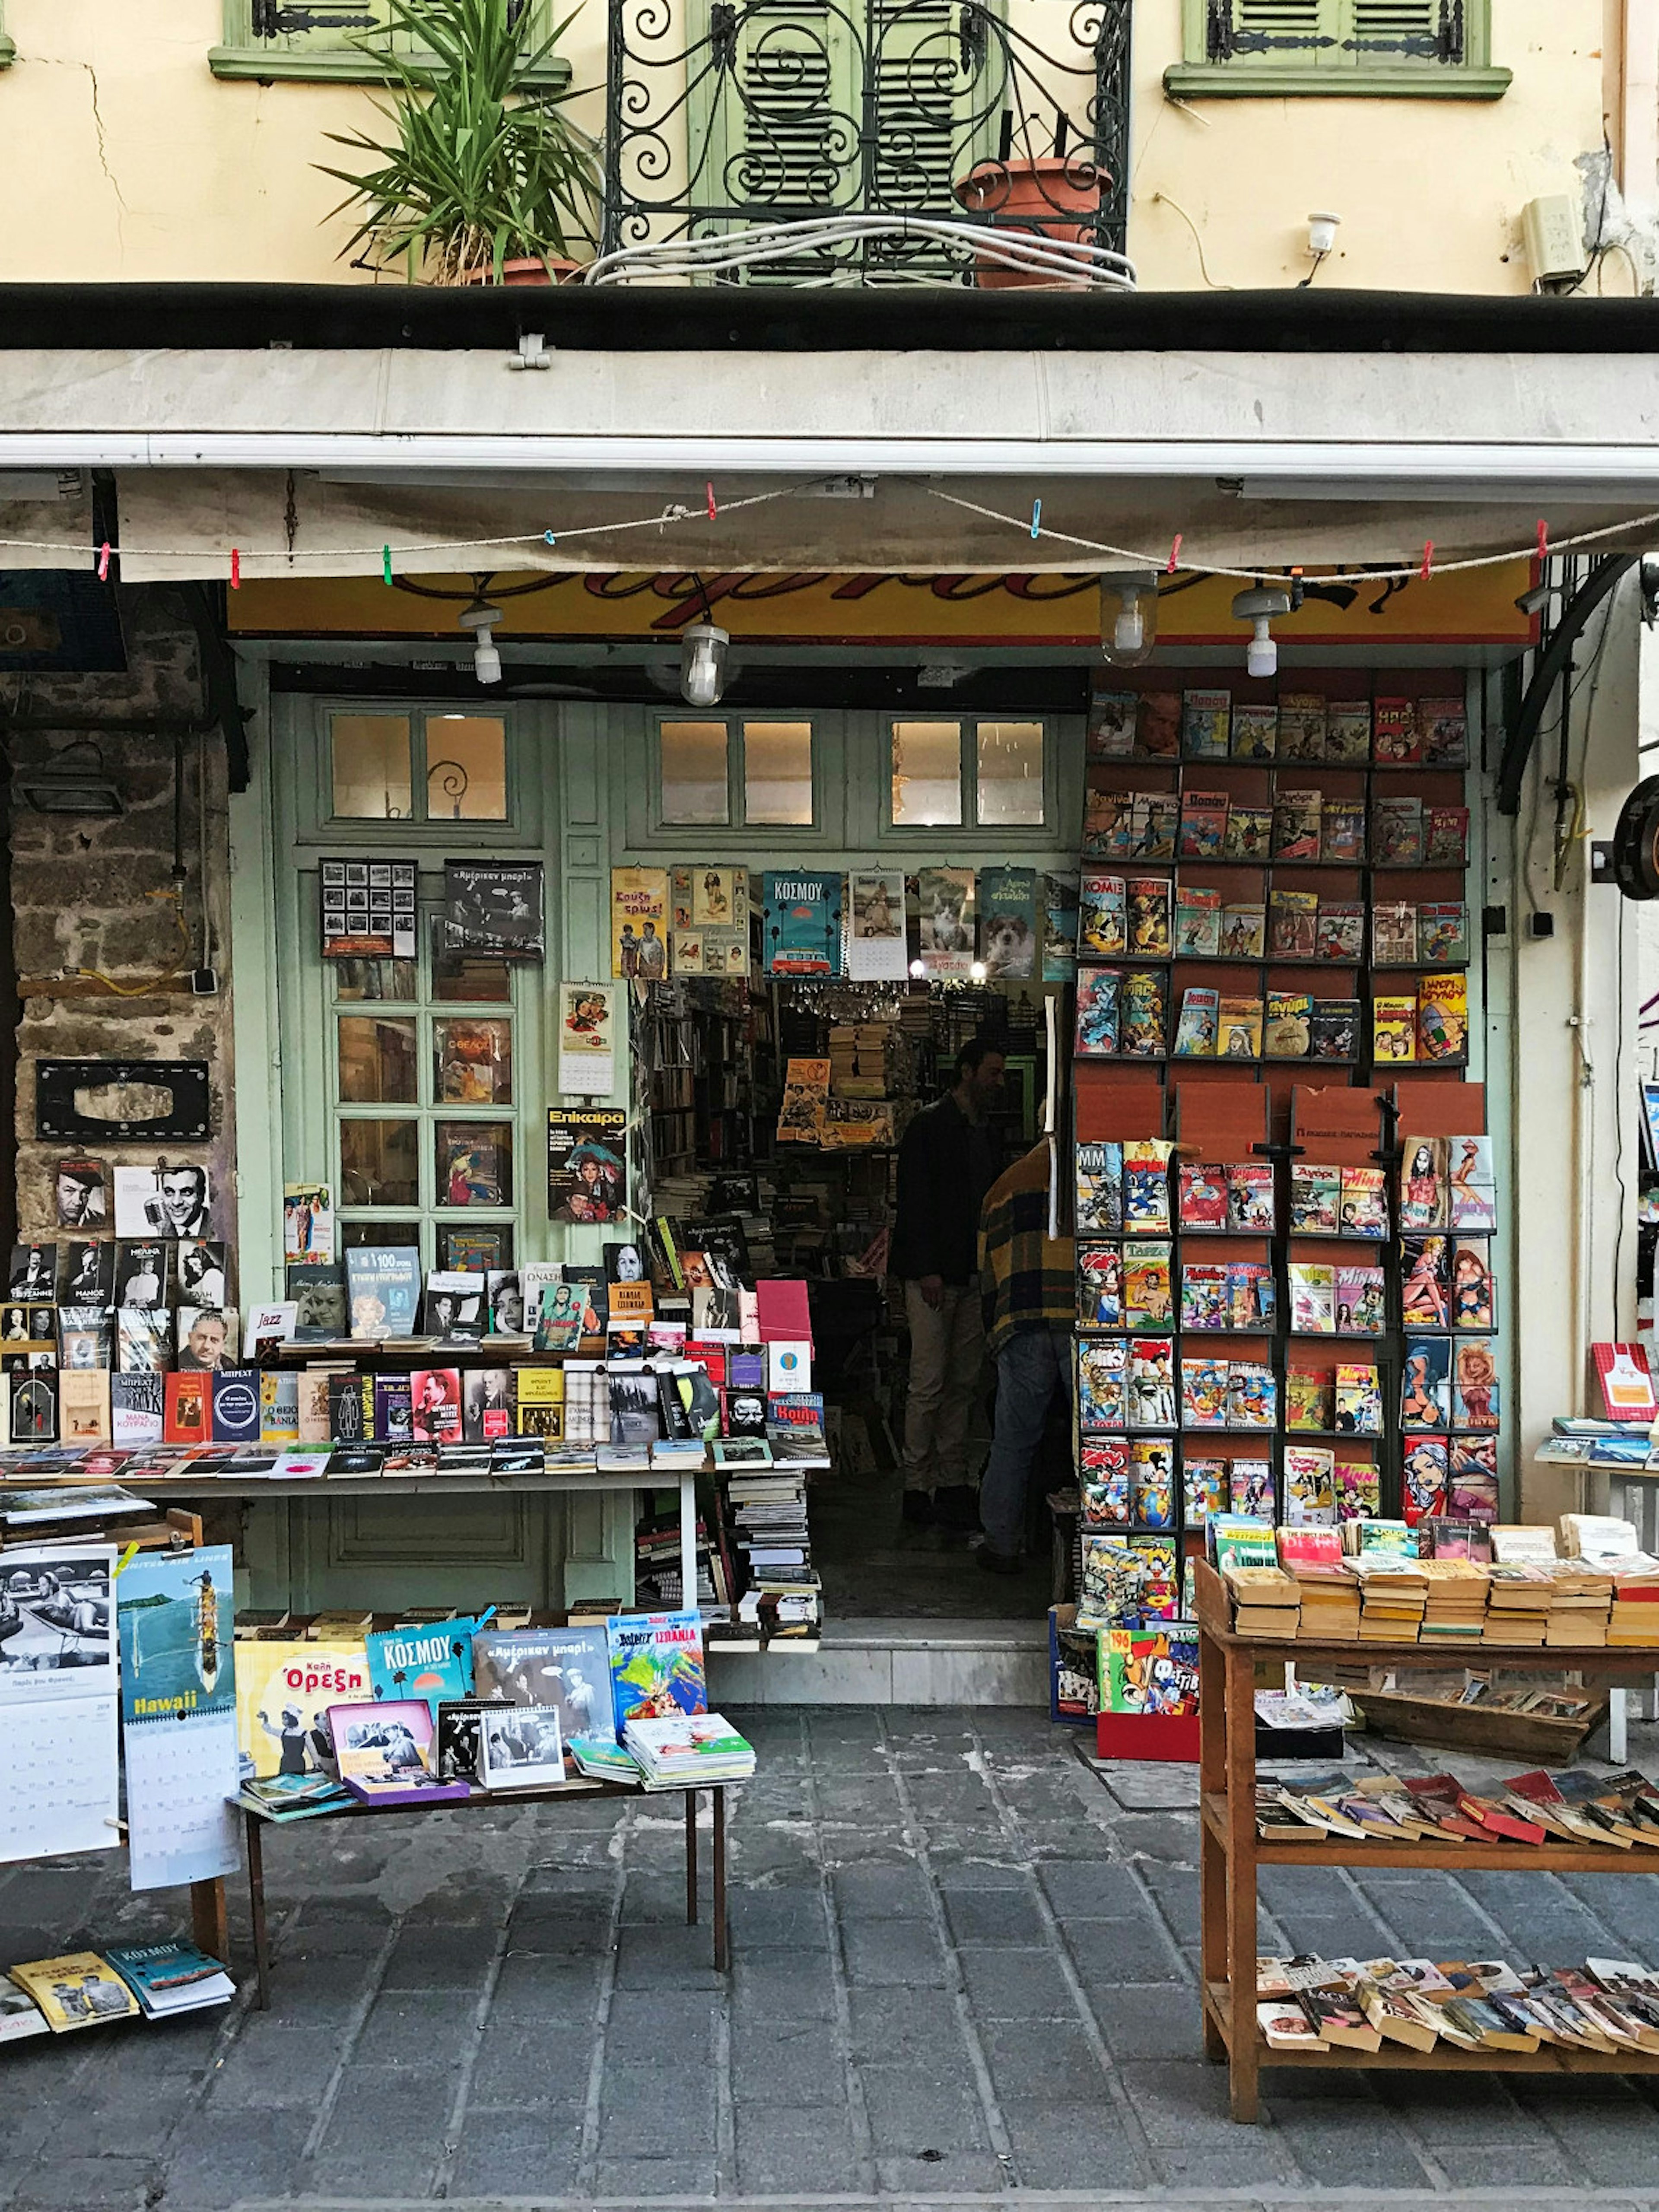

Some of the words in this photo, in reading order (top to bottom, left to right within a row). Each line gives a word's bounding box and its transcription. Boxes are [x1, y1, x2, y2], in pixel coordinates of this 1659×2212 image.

[775, 882, 822, 901] ΚΟΣΜΟΥ
[257, 1313, 282, 1329] Jazz
[170, 1557, 188, 1565] AIR
[655, 1629, 696, 1643] ΙΣΠΑΝΙΑ
[384, 1635, 451, 1670] ΚΟΣΜΟΥ
[487, 1644, 550, 1659] «Αμέρικαν
[552, 1641, 595, 1656] μπαρ!»
[306, 1662, 331, 1671] Καλή
[283, 1668, 362, 1692] Όρεξη
[134, 1690, 197, 1714] Hawaii
